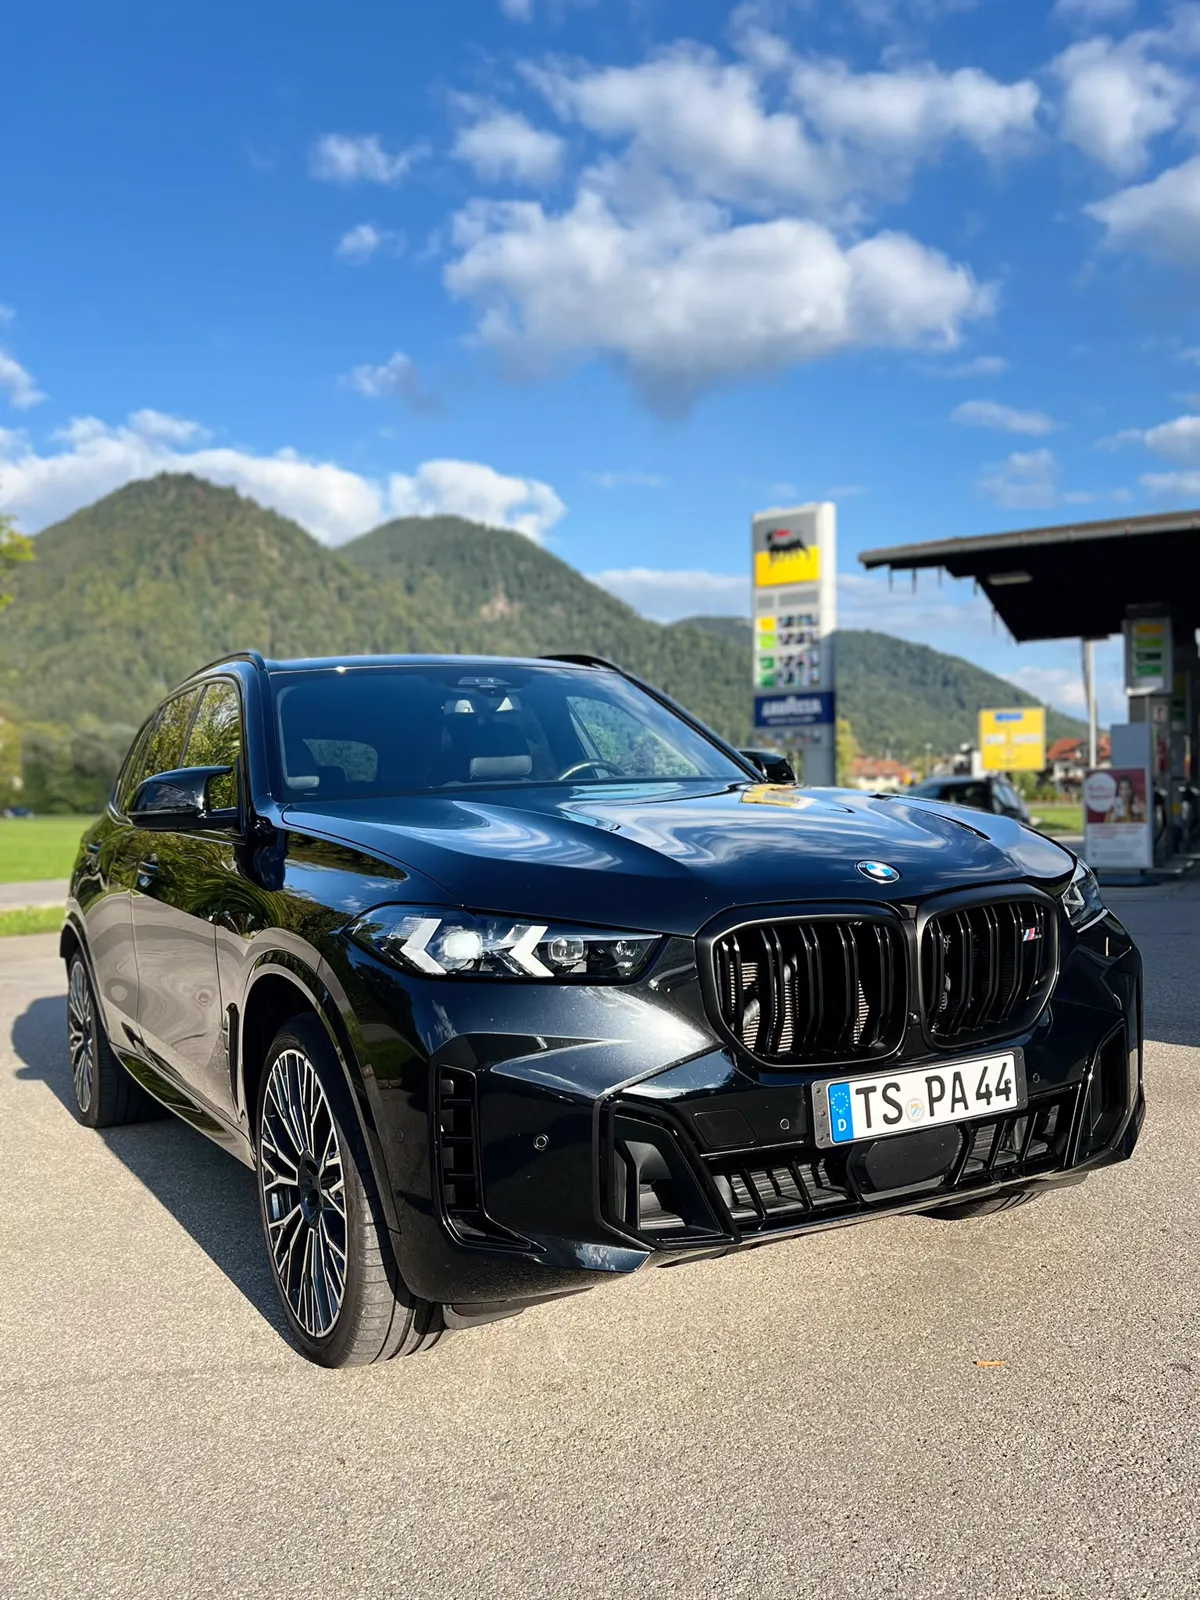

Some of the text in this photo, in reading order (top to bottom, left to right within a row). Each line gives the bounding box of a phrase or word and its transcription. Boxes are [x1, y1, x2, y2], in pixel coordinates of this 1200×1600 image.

[855, 1062, 1012, 1128] TS PA 44
[837, 1118, 847, 1132] D
